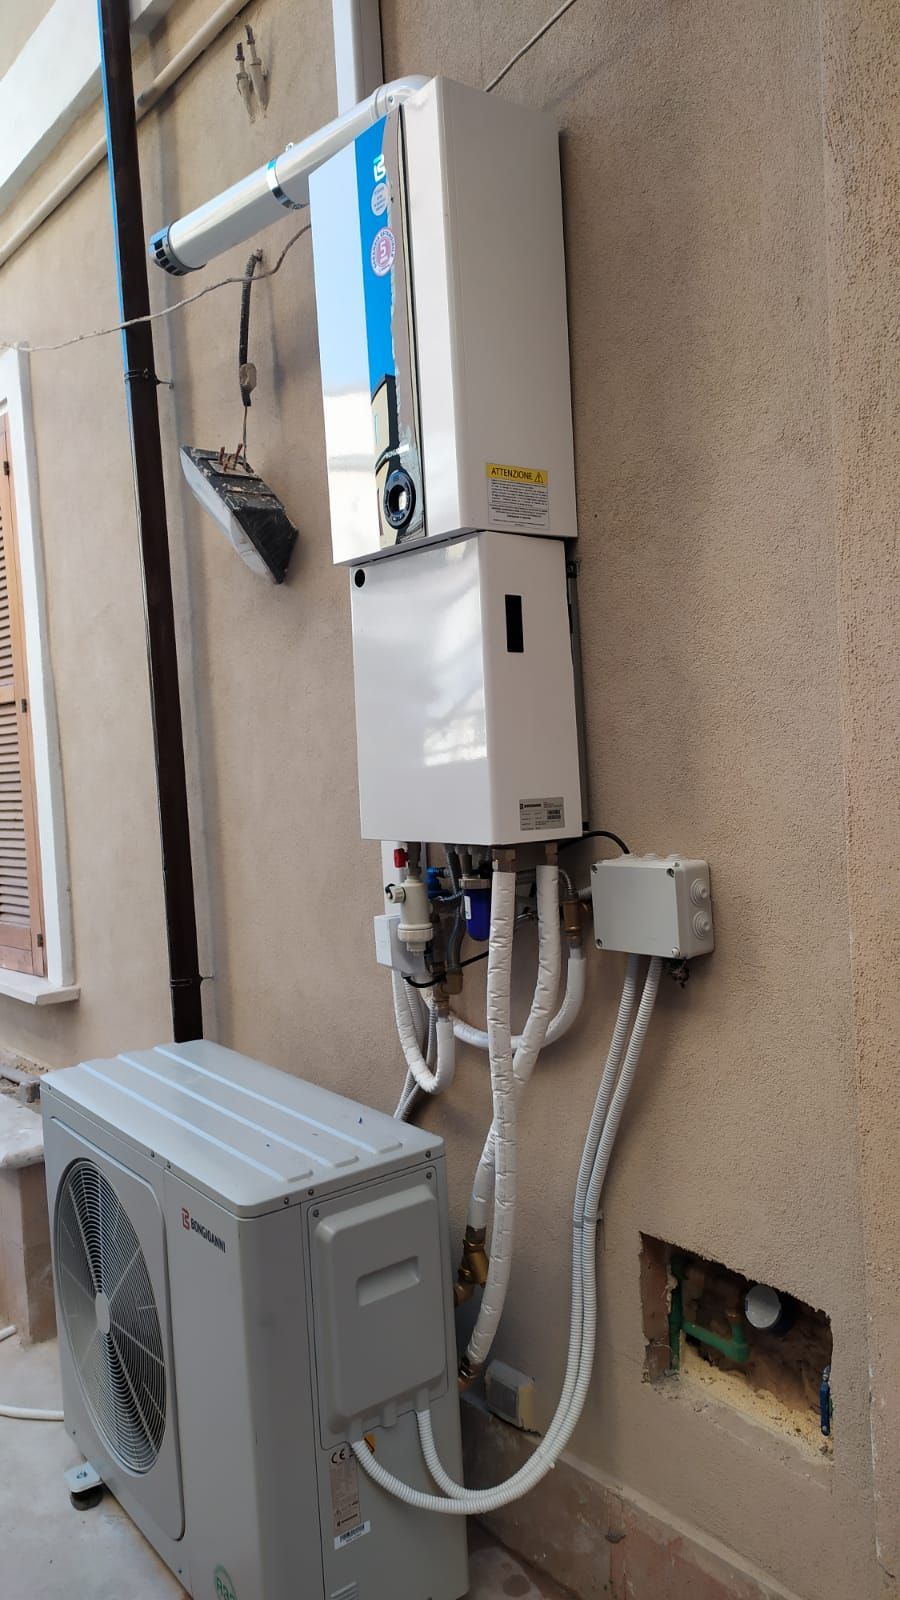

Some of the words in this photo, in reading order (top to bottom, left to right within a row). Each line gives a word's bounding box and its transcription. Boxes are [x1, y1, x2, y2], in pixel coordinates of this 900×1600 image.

[379, 239, 388, 257] 5
[491, 466, 533, 480] ATTENZIONE
[190, 1217, 226, 1254] BONGIOANNI
[331, 1448, 346, 1464] CE
